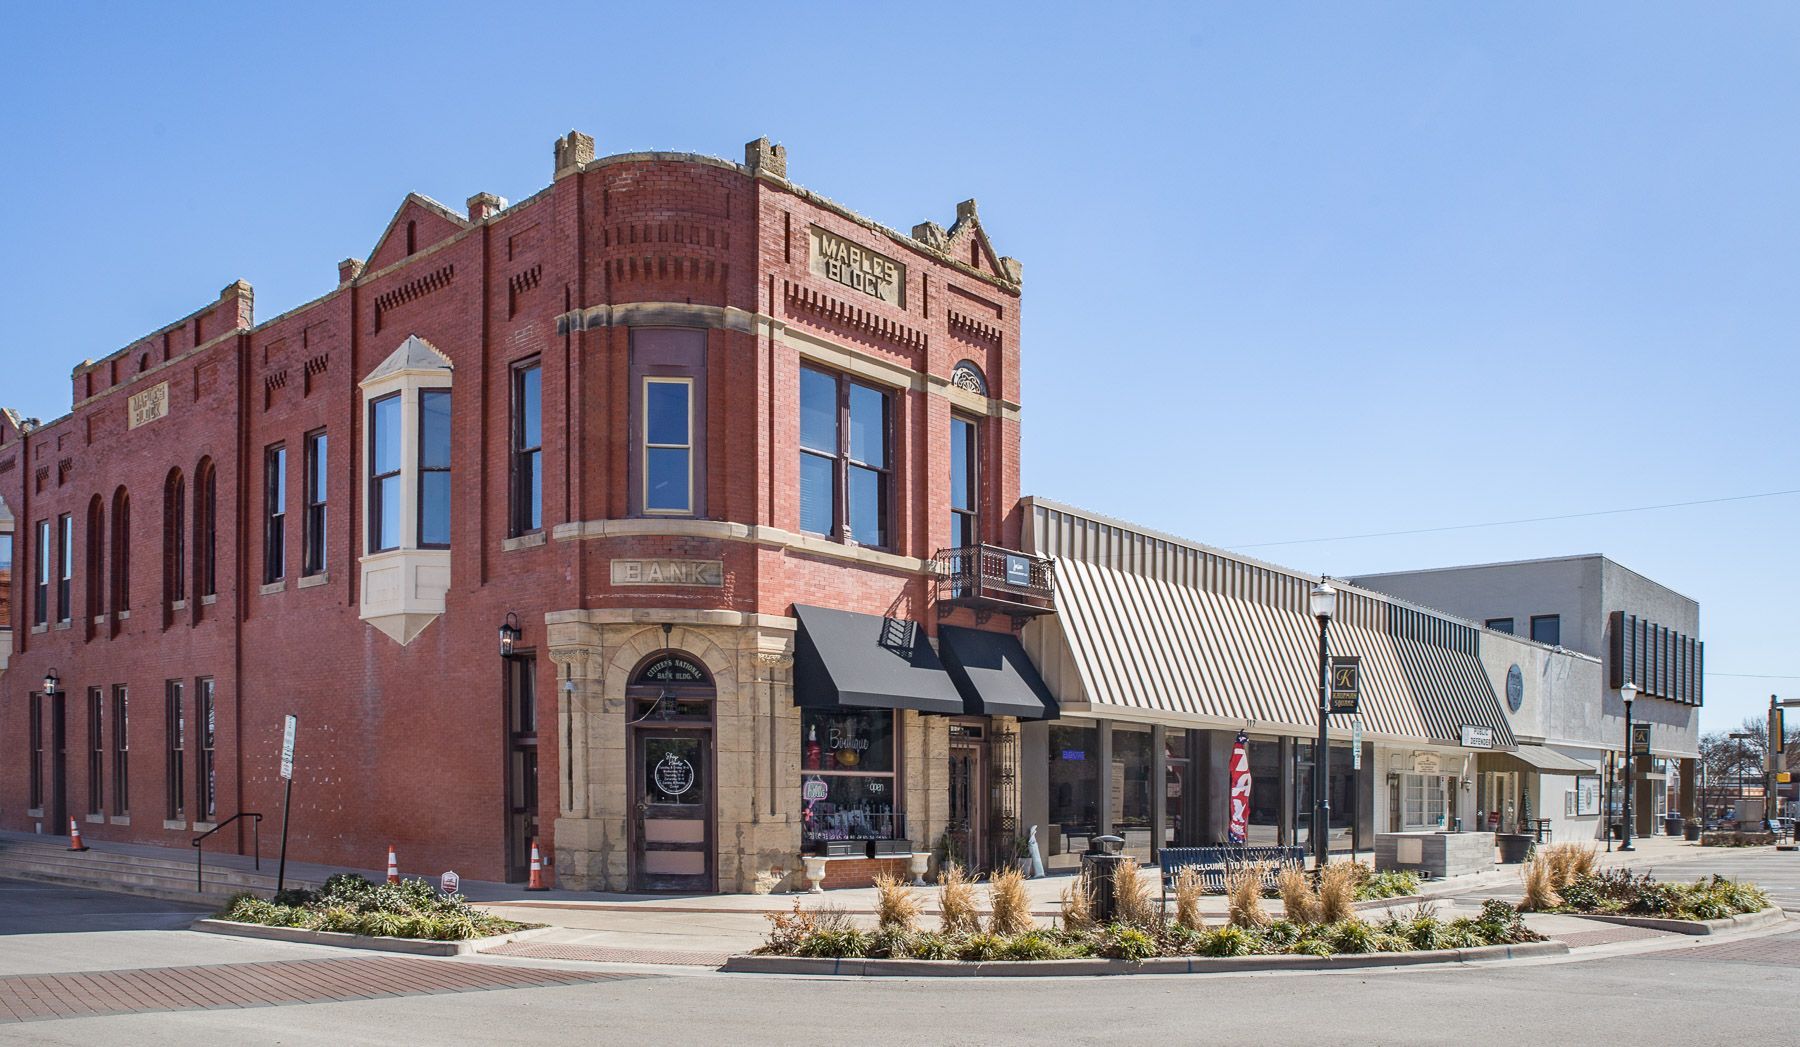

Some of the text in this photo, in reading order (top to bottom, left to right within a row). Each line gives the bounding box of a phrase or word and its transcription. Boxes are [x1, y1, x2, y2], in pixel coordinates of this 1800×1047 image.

[828, 259, 886, 301] BLOCK
[624, 562, 707, 583] BANK
[674, 659, 702, 679] NATIONAL
[1336, 669, 1354, 688] K
[829, 728, 869, 753] Boutique
[1473, 727, 1489, 736] PUBLIC
[1470, 737, 1491, 746] DEFENDER
[869, 783, 885, 793] open
